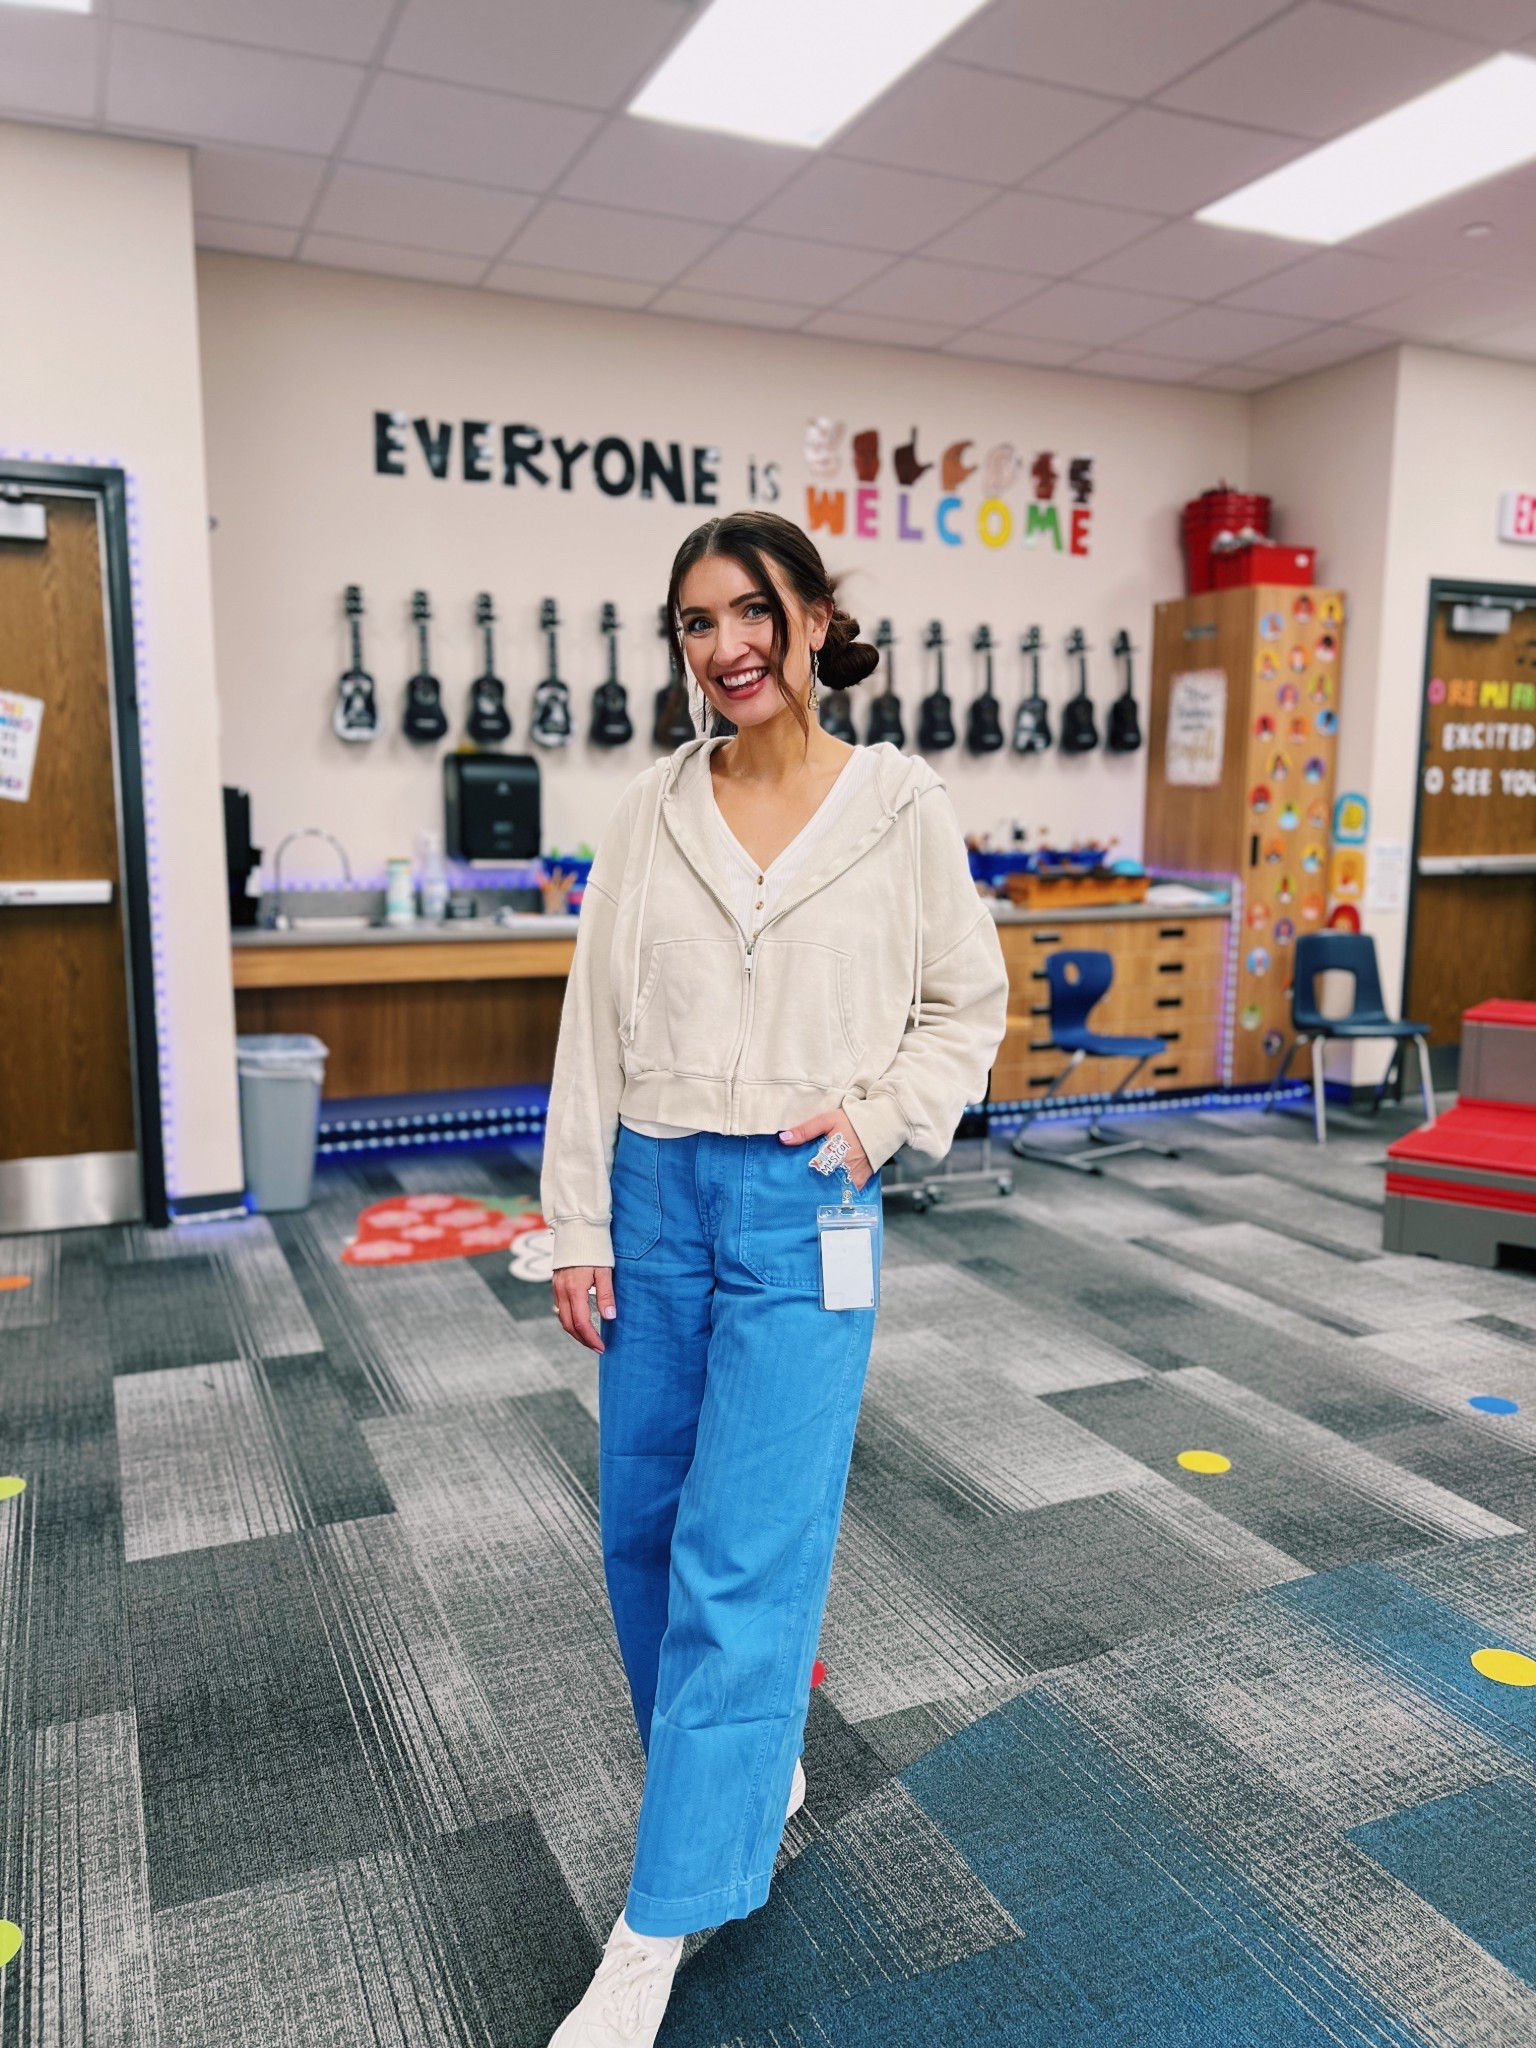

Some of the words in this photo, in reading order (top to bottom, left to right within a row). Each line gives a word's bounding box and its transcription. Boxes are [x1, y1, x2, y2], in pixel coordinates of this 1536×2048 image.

[373, 410, 719, 506] EVERYONE
[805, 486, 1094, 556] WELCOME
[1443, 723, 1535, 751] EXCITED
[1451, 766, 1492, 796] SEE
